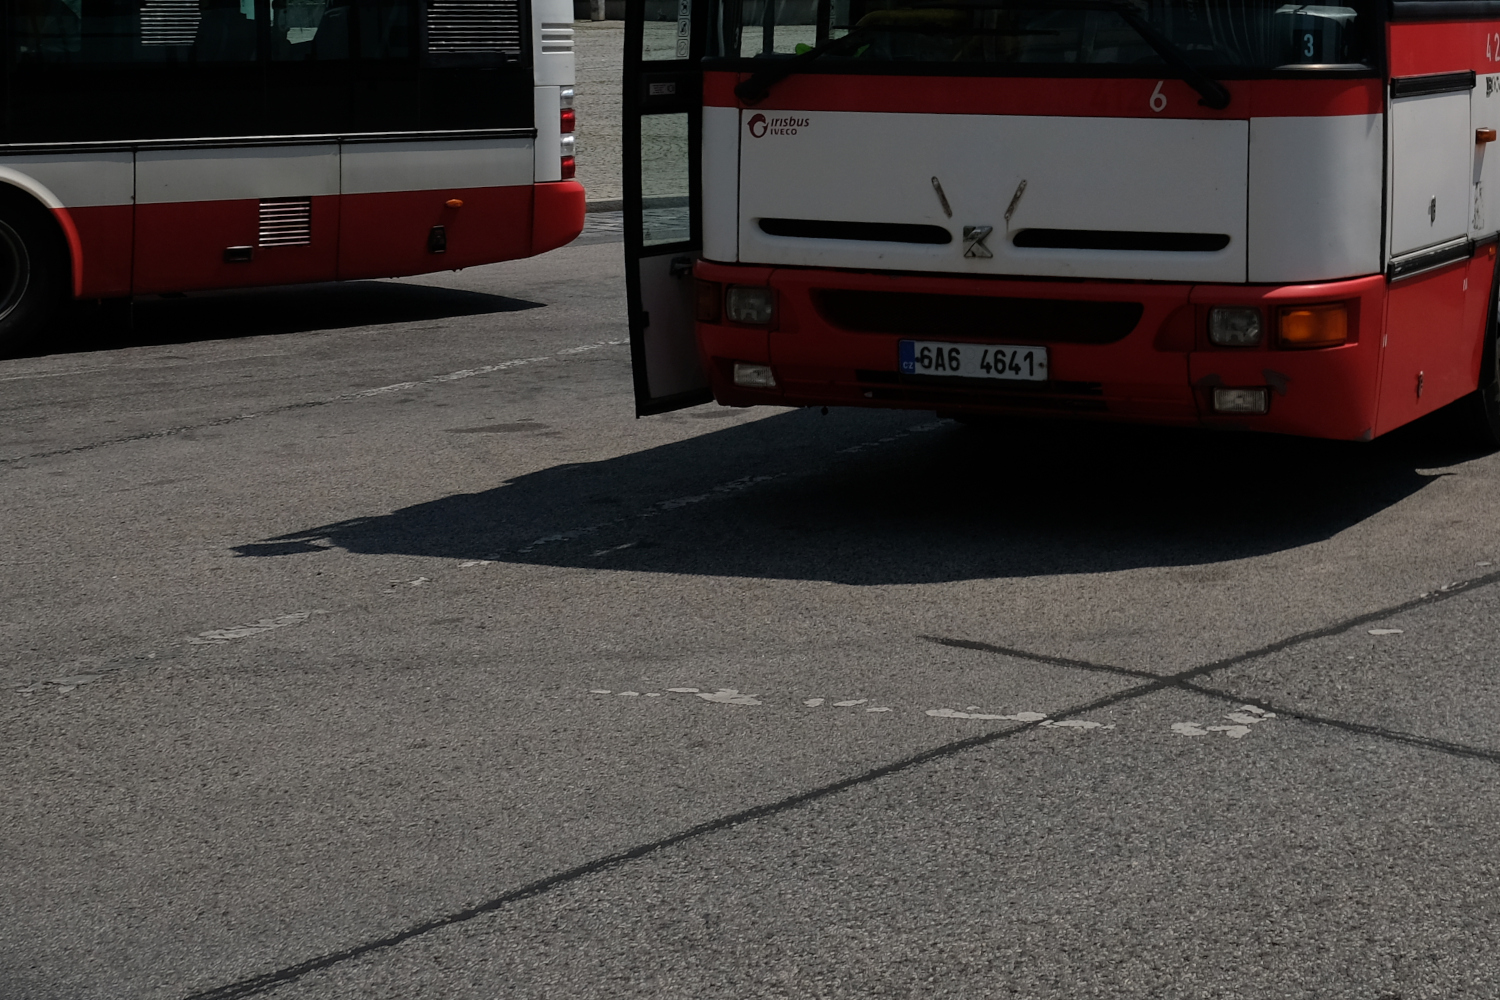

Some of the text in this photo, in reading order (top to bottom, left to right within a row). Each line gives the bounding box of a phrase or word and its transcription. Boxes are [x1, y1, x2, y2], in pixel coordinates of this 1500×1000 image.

[1303, 33, 1314, 57] 3
[1149, 80, 1167, 113] 6
[770, 116, 810, 127] irisbus
[903, 346, 1034, 377] CZ 6A6 4641
